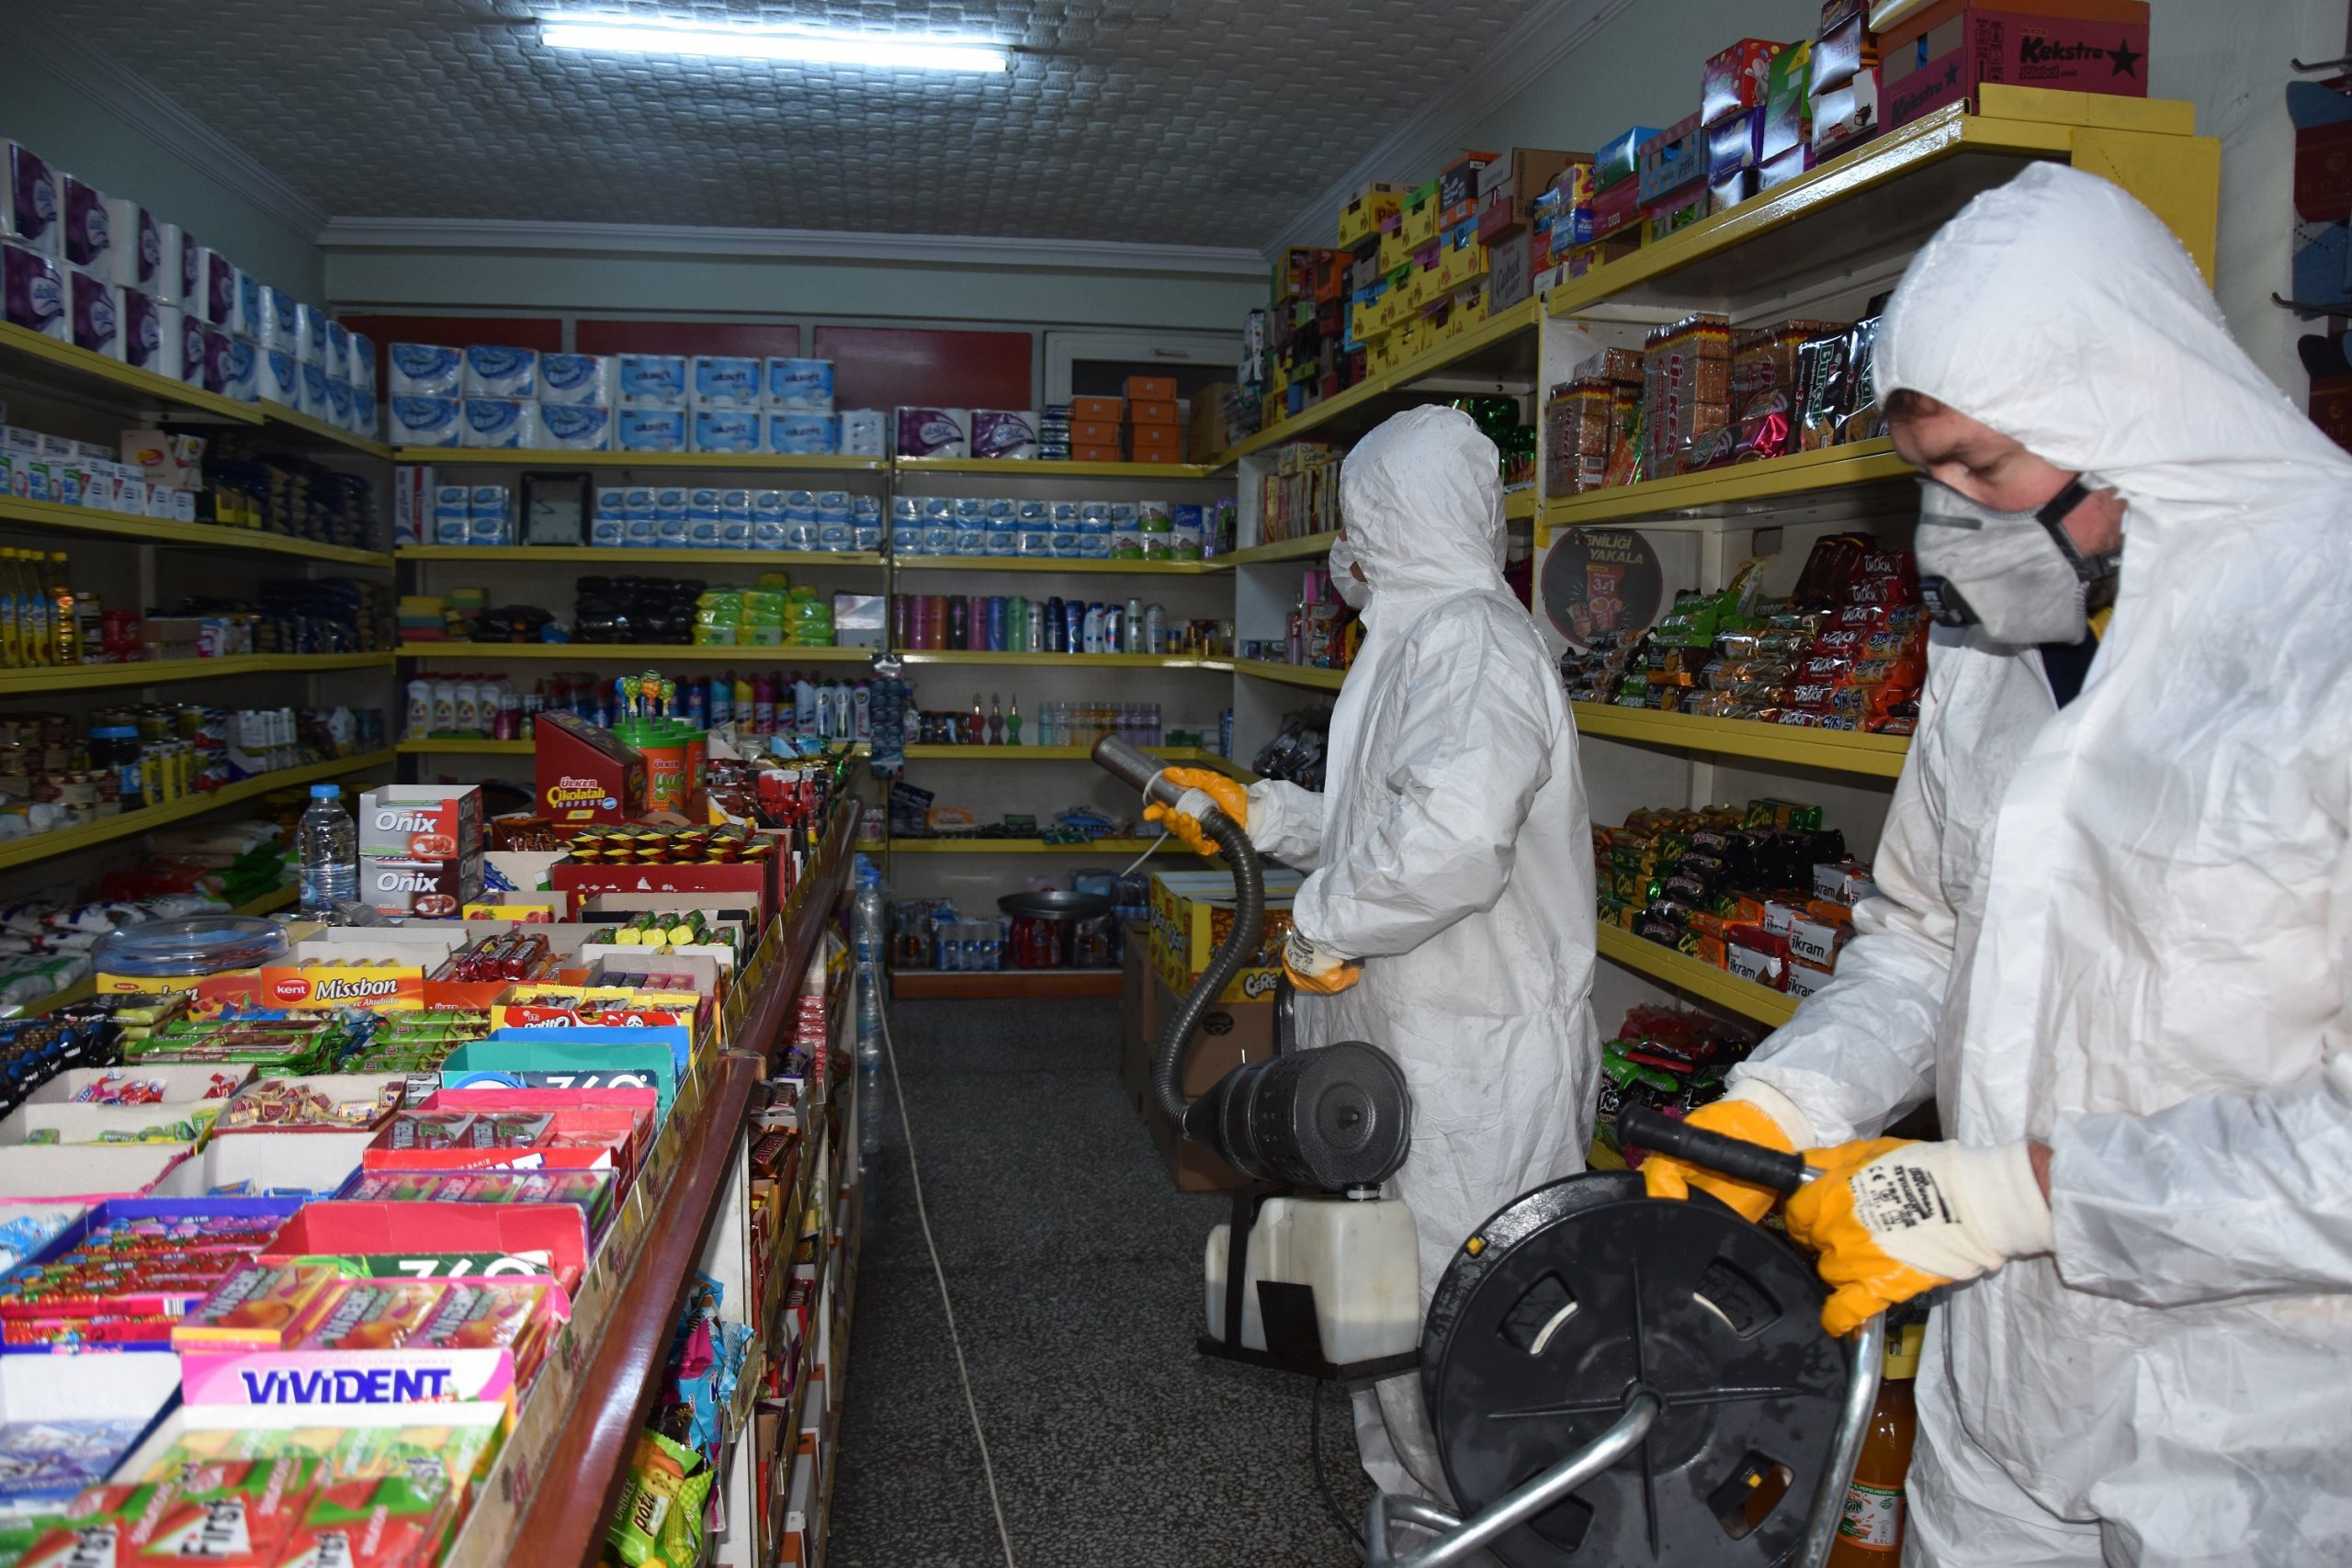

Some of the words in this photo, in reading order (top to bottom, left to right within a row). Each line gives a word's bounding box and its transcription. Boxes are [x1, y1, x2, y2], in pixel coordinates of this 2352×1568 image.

[2020, 36, 2103, 62] Kekstra
[1666, 353, 1684, 459] ÜLKER
[1589, 548, 1645, 565] YAKALA
[654, 758, 680, 768] ÜLKER
[560, 776, 597, 788] ÜLKER
[547, 786, 605, 808] Çikolatalı
[375, 811, 437, 832] Onix
[377, 872, 440, 892] Onix
[1792, 935, 1825, 958] ikram
[1730, 959, 1756, 980] ikram
[277, 986, 307, 995] kent
[316, 978, 398, 1001] Missbon
[1244, 972, 1277, 998] CERE
[363, 997, 398, 1007] Ahududu
